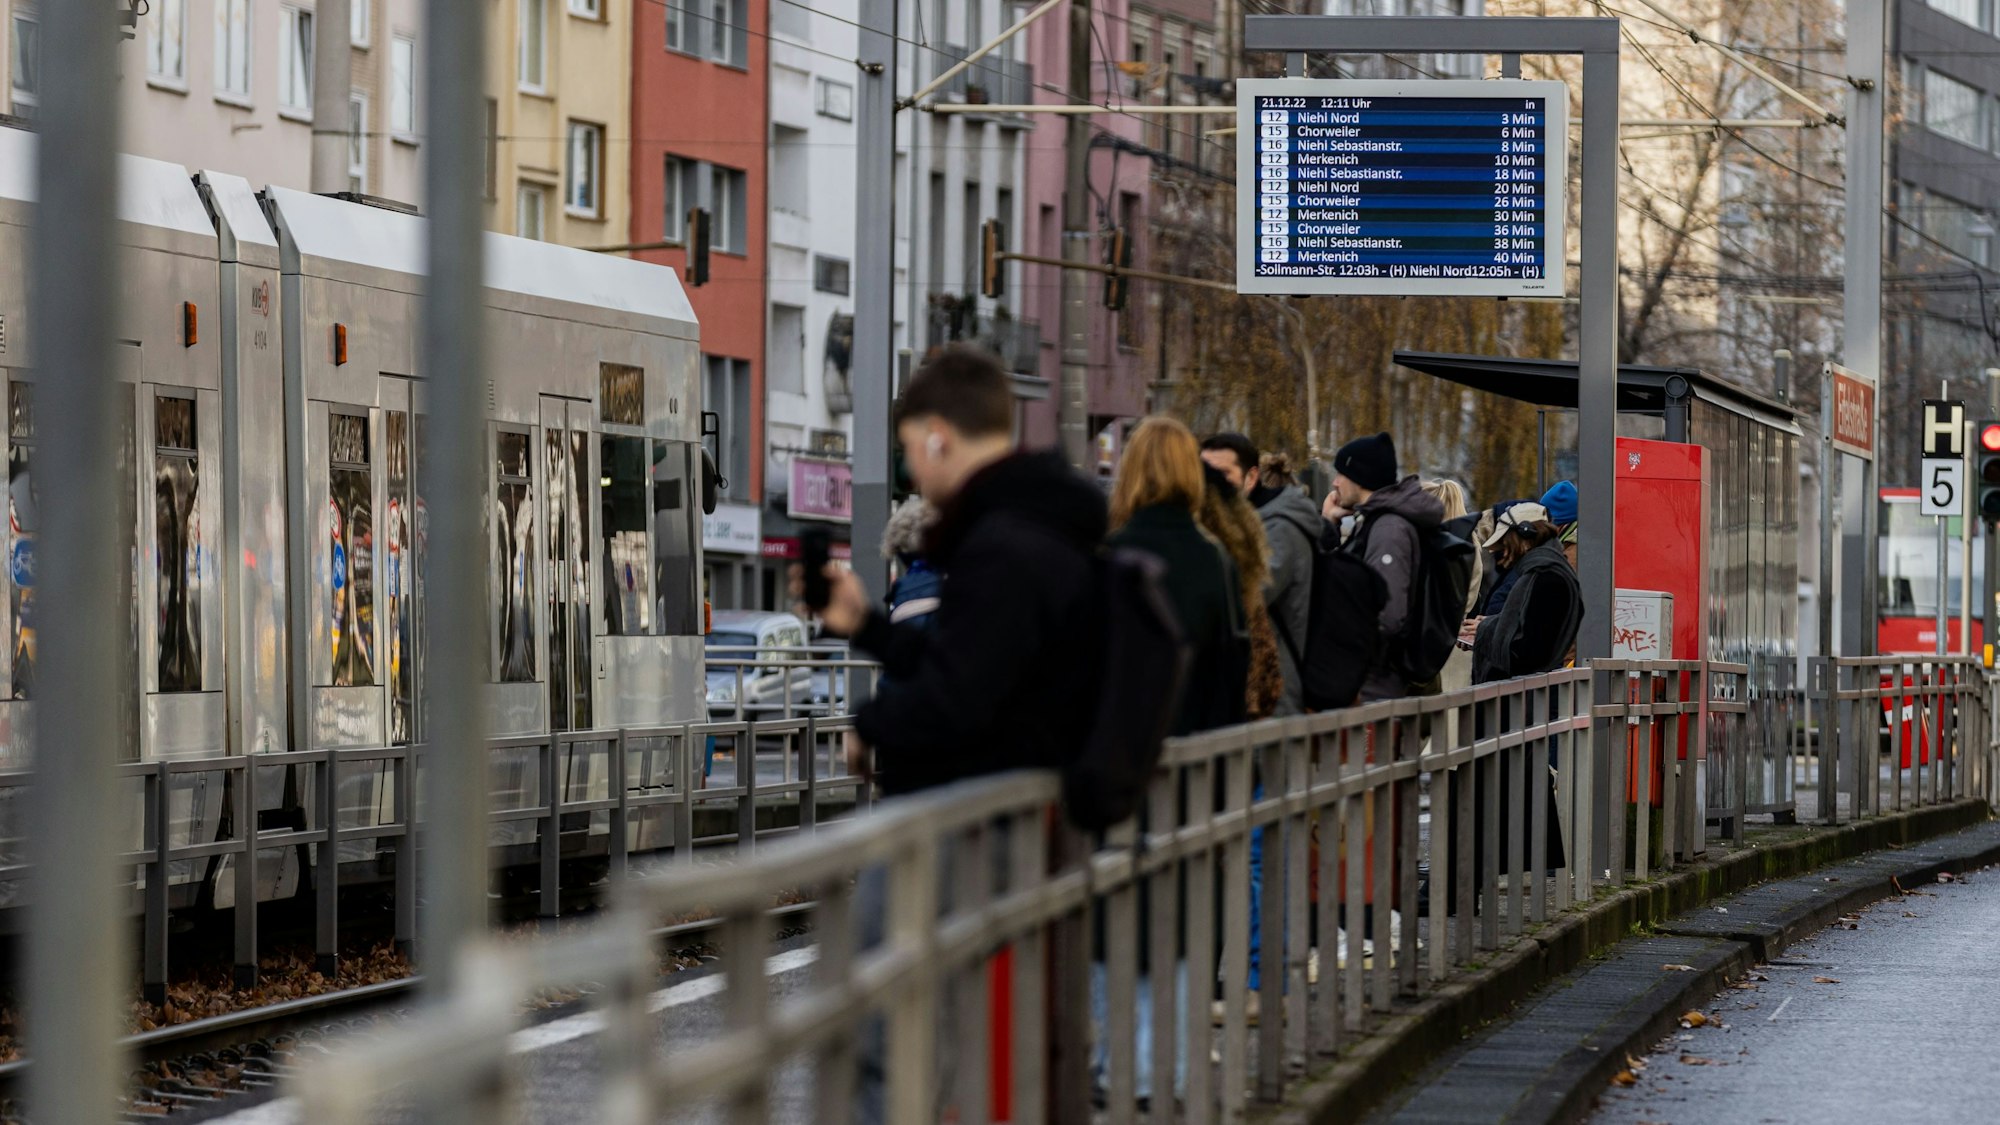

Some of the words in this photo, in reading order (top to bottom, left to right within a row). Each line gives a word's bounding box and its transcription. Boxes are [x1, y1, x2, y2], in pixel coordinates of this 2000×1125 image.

[1262, 98, 1306, 108] 21.12.22
[1321, 98, 1349, 108] 12:11
[1352, 98, 1372, 108] Uhr
[1525, 99, 1536, 110] in
[1268, 112, 1282, 121] 12
[1298, 112, 1327, 124] Niehl
[1330, 112, 1360, 124] Nord
[1502, 114, 1509, 125] 3
[1512, 114, 1535, 125] Min
[1268, 126, 1282, 136] 15
[1297, 126, 1361, 138] Chorweiler
[1502, 127, 1509, 138] 6
[1512, 127, 1535, 138] Min
[1268, 140, 1282, 149] 16
[1298, 140, 1327, 152] Niehl
[1330, 140, 1403, 152] Sebastianstr.
[1502, 141, 1509, 152] 8
[1512, 141, 1535, 152] Min
[1268, 154, 1282, 163] 12
[1298, 154, 1359, 165] Merkenich
[1494, 155, 1509, 166] 10
[1512, 155, 1535, 166] Min
[1268, 168, 1282, 177] 16
[1298, 167, 1327, 179] Niehl
[1330, 167, 1403, 179] Sebastianstr.
[1494, 169, 1509, 180] 18
[1512, 169, 1535, 180] Min
[1268, 182, 1282, 191] 12
[1298, 181, 1327, 193] Niehl
[1330, 181, 1360, 193] Nord
[1494, 183, 1509, 194] 20
[1512, 183, 1535, 194] Min
[1268, 196, 1282, 205] 15
[1297, 195, 1361, 207] Chorweiler
[1494, 197, 1509, 208] 26
[1512, 197, 1535, 208] Min
[1268, 210, 1282, 219] 12
[1298, 209, 1359, 220] Merkenich
[1494, 211, 1509, 222] 30
[1512, 211, 1535, 222] Min
[1268, 223, 1282, 233] 15
[1297, 223, 1361, 235] Chorweiler
[1494, 225, 1509, 236] 36
[1512, 225, 1535, 236] Min
[1268, 237, 1282, 247] 16
[1298, 237, 1327, 249] Niehl
[1330, 237, 1403, 249] Sebastianstr.
[1494, 239, 1509, 250] 38
[1512, 239, 1535, 250] Min
[1268, 251, 1282, 260] 12
[1298, 251, 1359, 262] Merkenich
[1494, 253, 1509, 264] 40
[1512, 253, 1535, 264] Min
[1340, 265, 1379, 276] 12:03h
[1389, 265, 1407, 278] (H)
[1410, 265, 1440, 276] Niehl
[1521, 266, 1540, 279] (H)
[1924, 405, 1963, 453] H
[1931, 466, 1954, 507] 5
